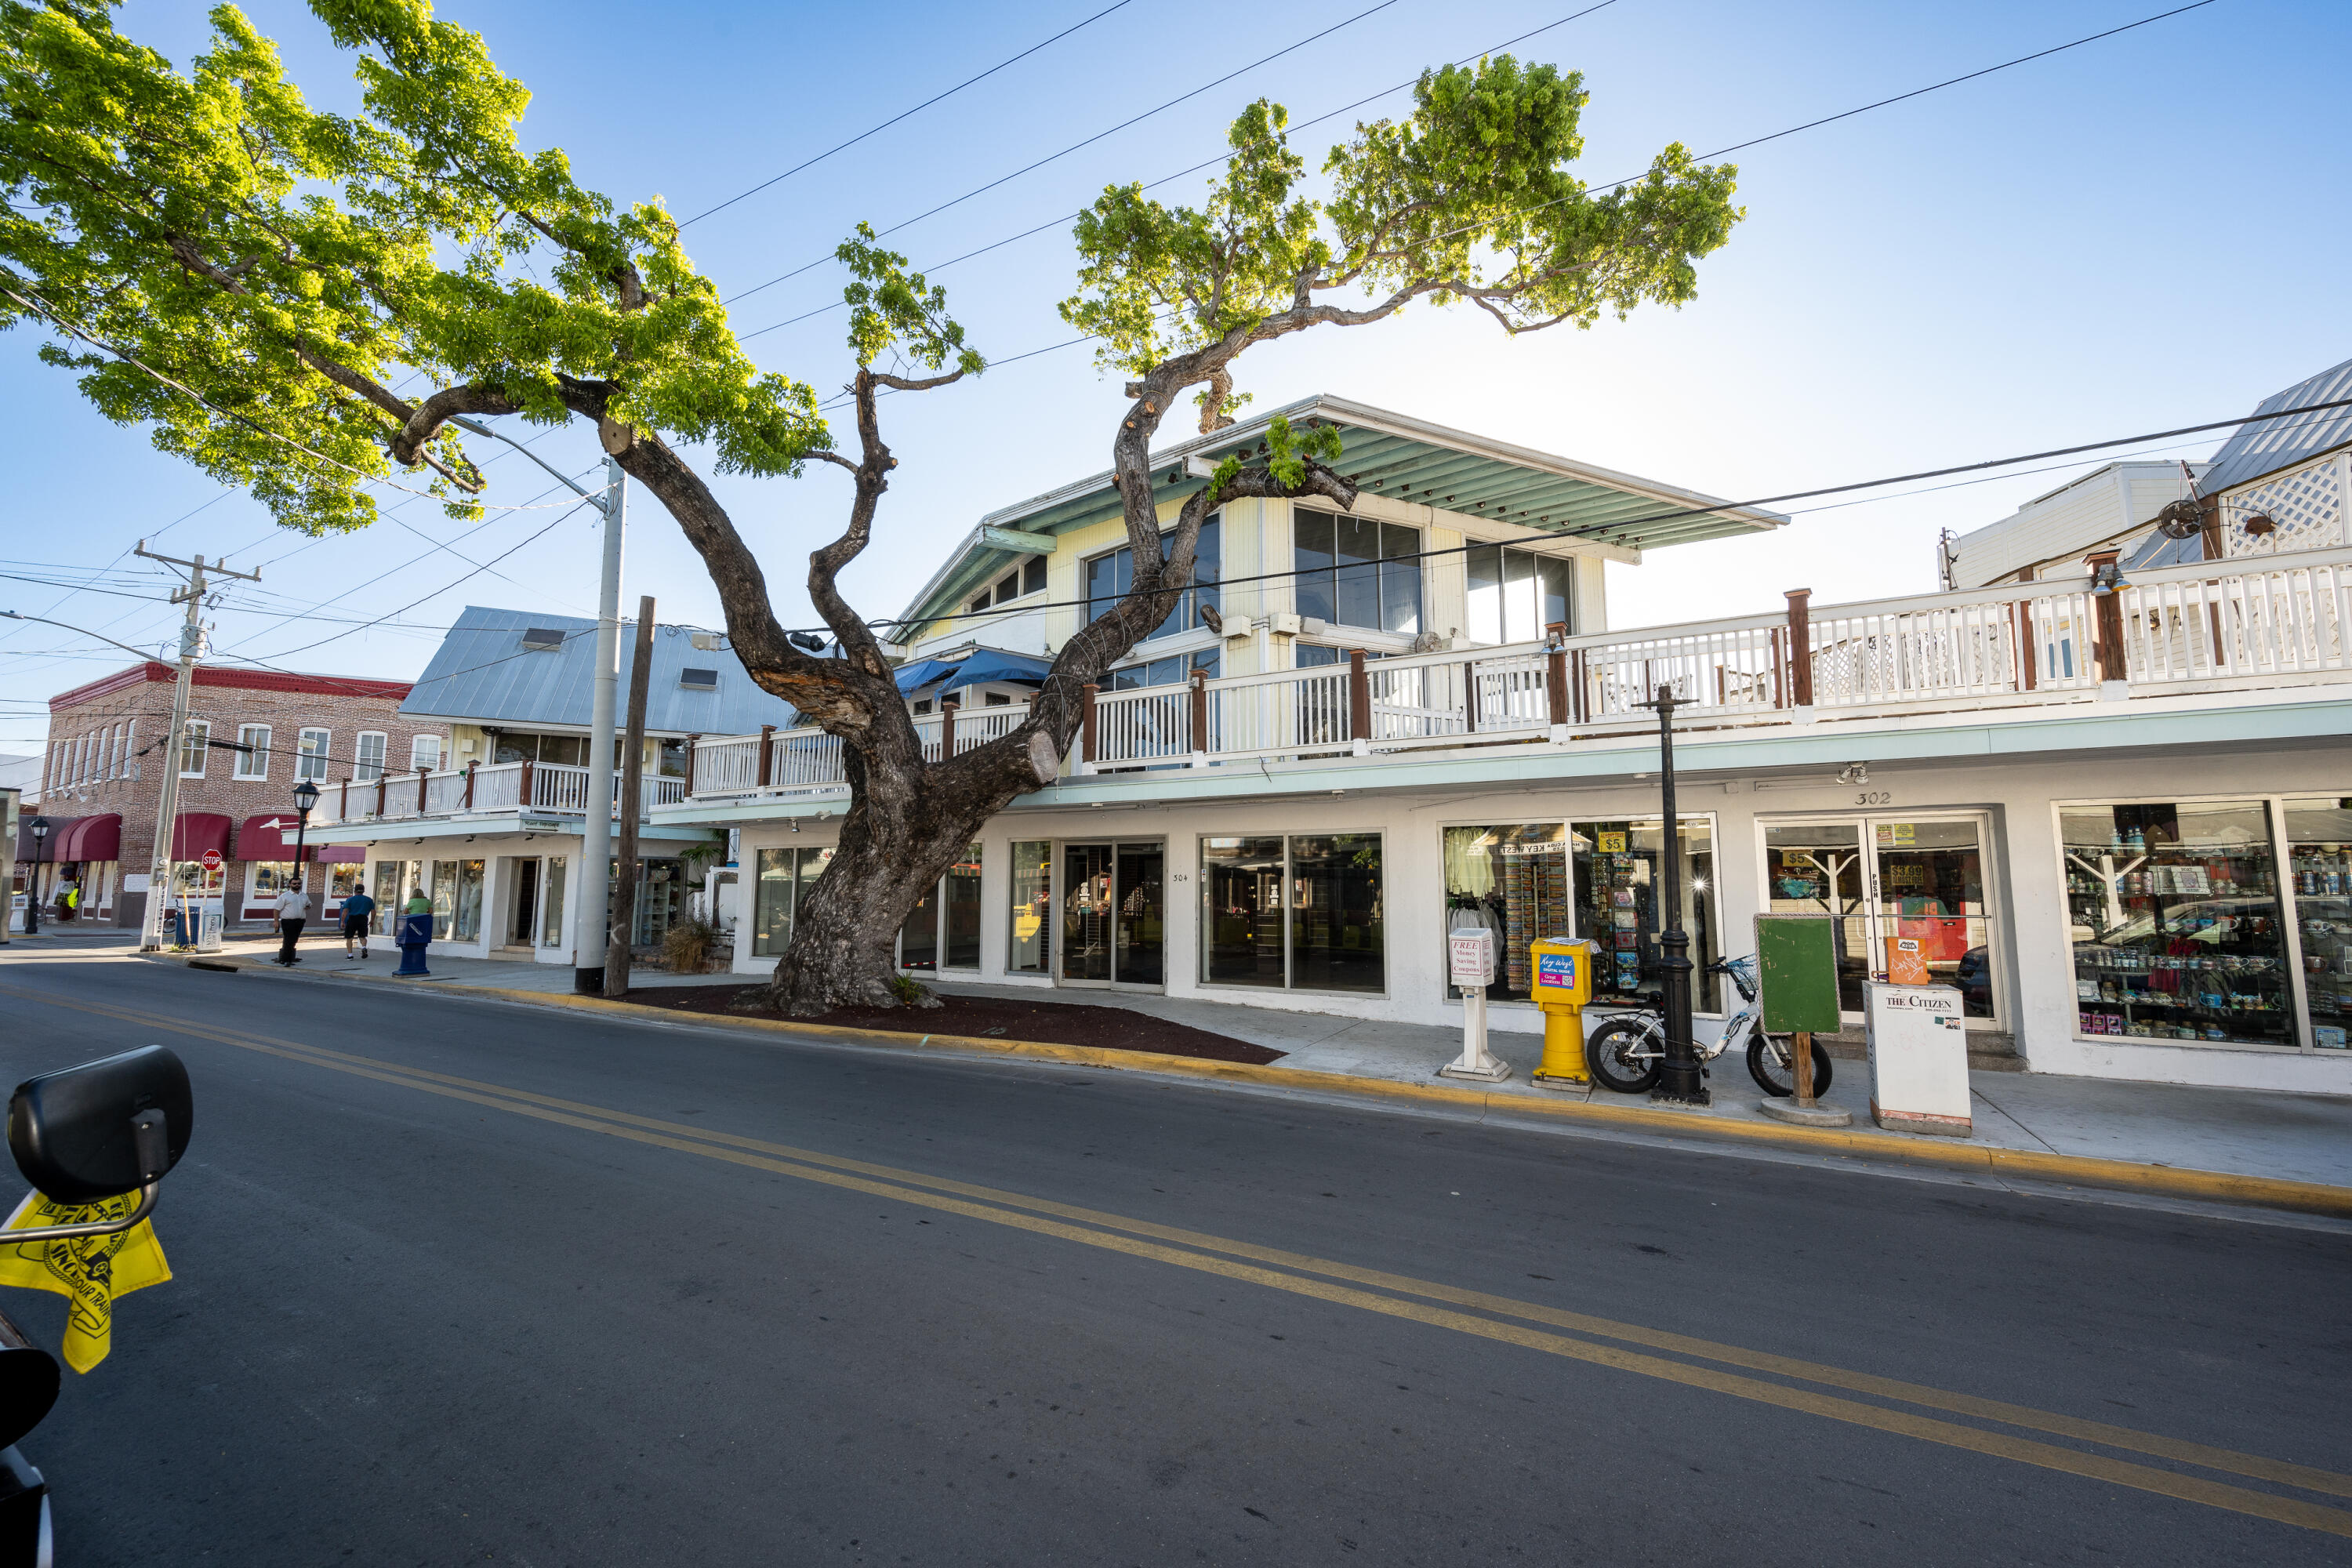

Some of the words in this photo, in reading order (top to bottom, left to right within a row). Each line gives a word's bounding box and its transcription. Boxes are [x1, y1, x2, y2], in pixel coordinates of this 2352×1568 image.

[1855, 792, 1891, 805] 302
[1606, 837, 1621, 851] $5
[204, 856, 220, 865] STOP
[1789, 852, 1806, 864] $5
[1541, 955, 1555, 967] Key
[1555, 957, 1573, 969] West
[1886, 997, 1906, 1006] THE
